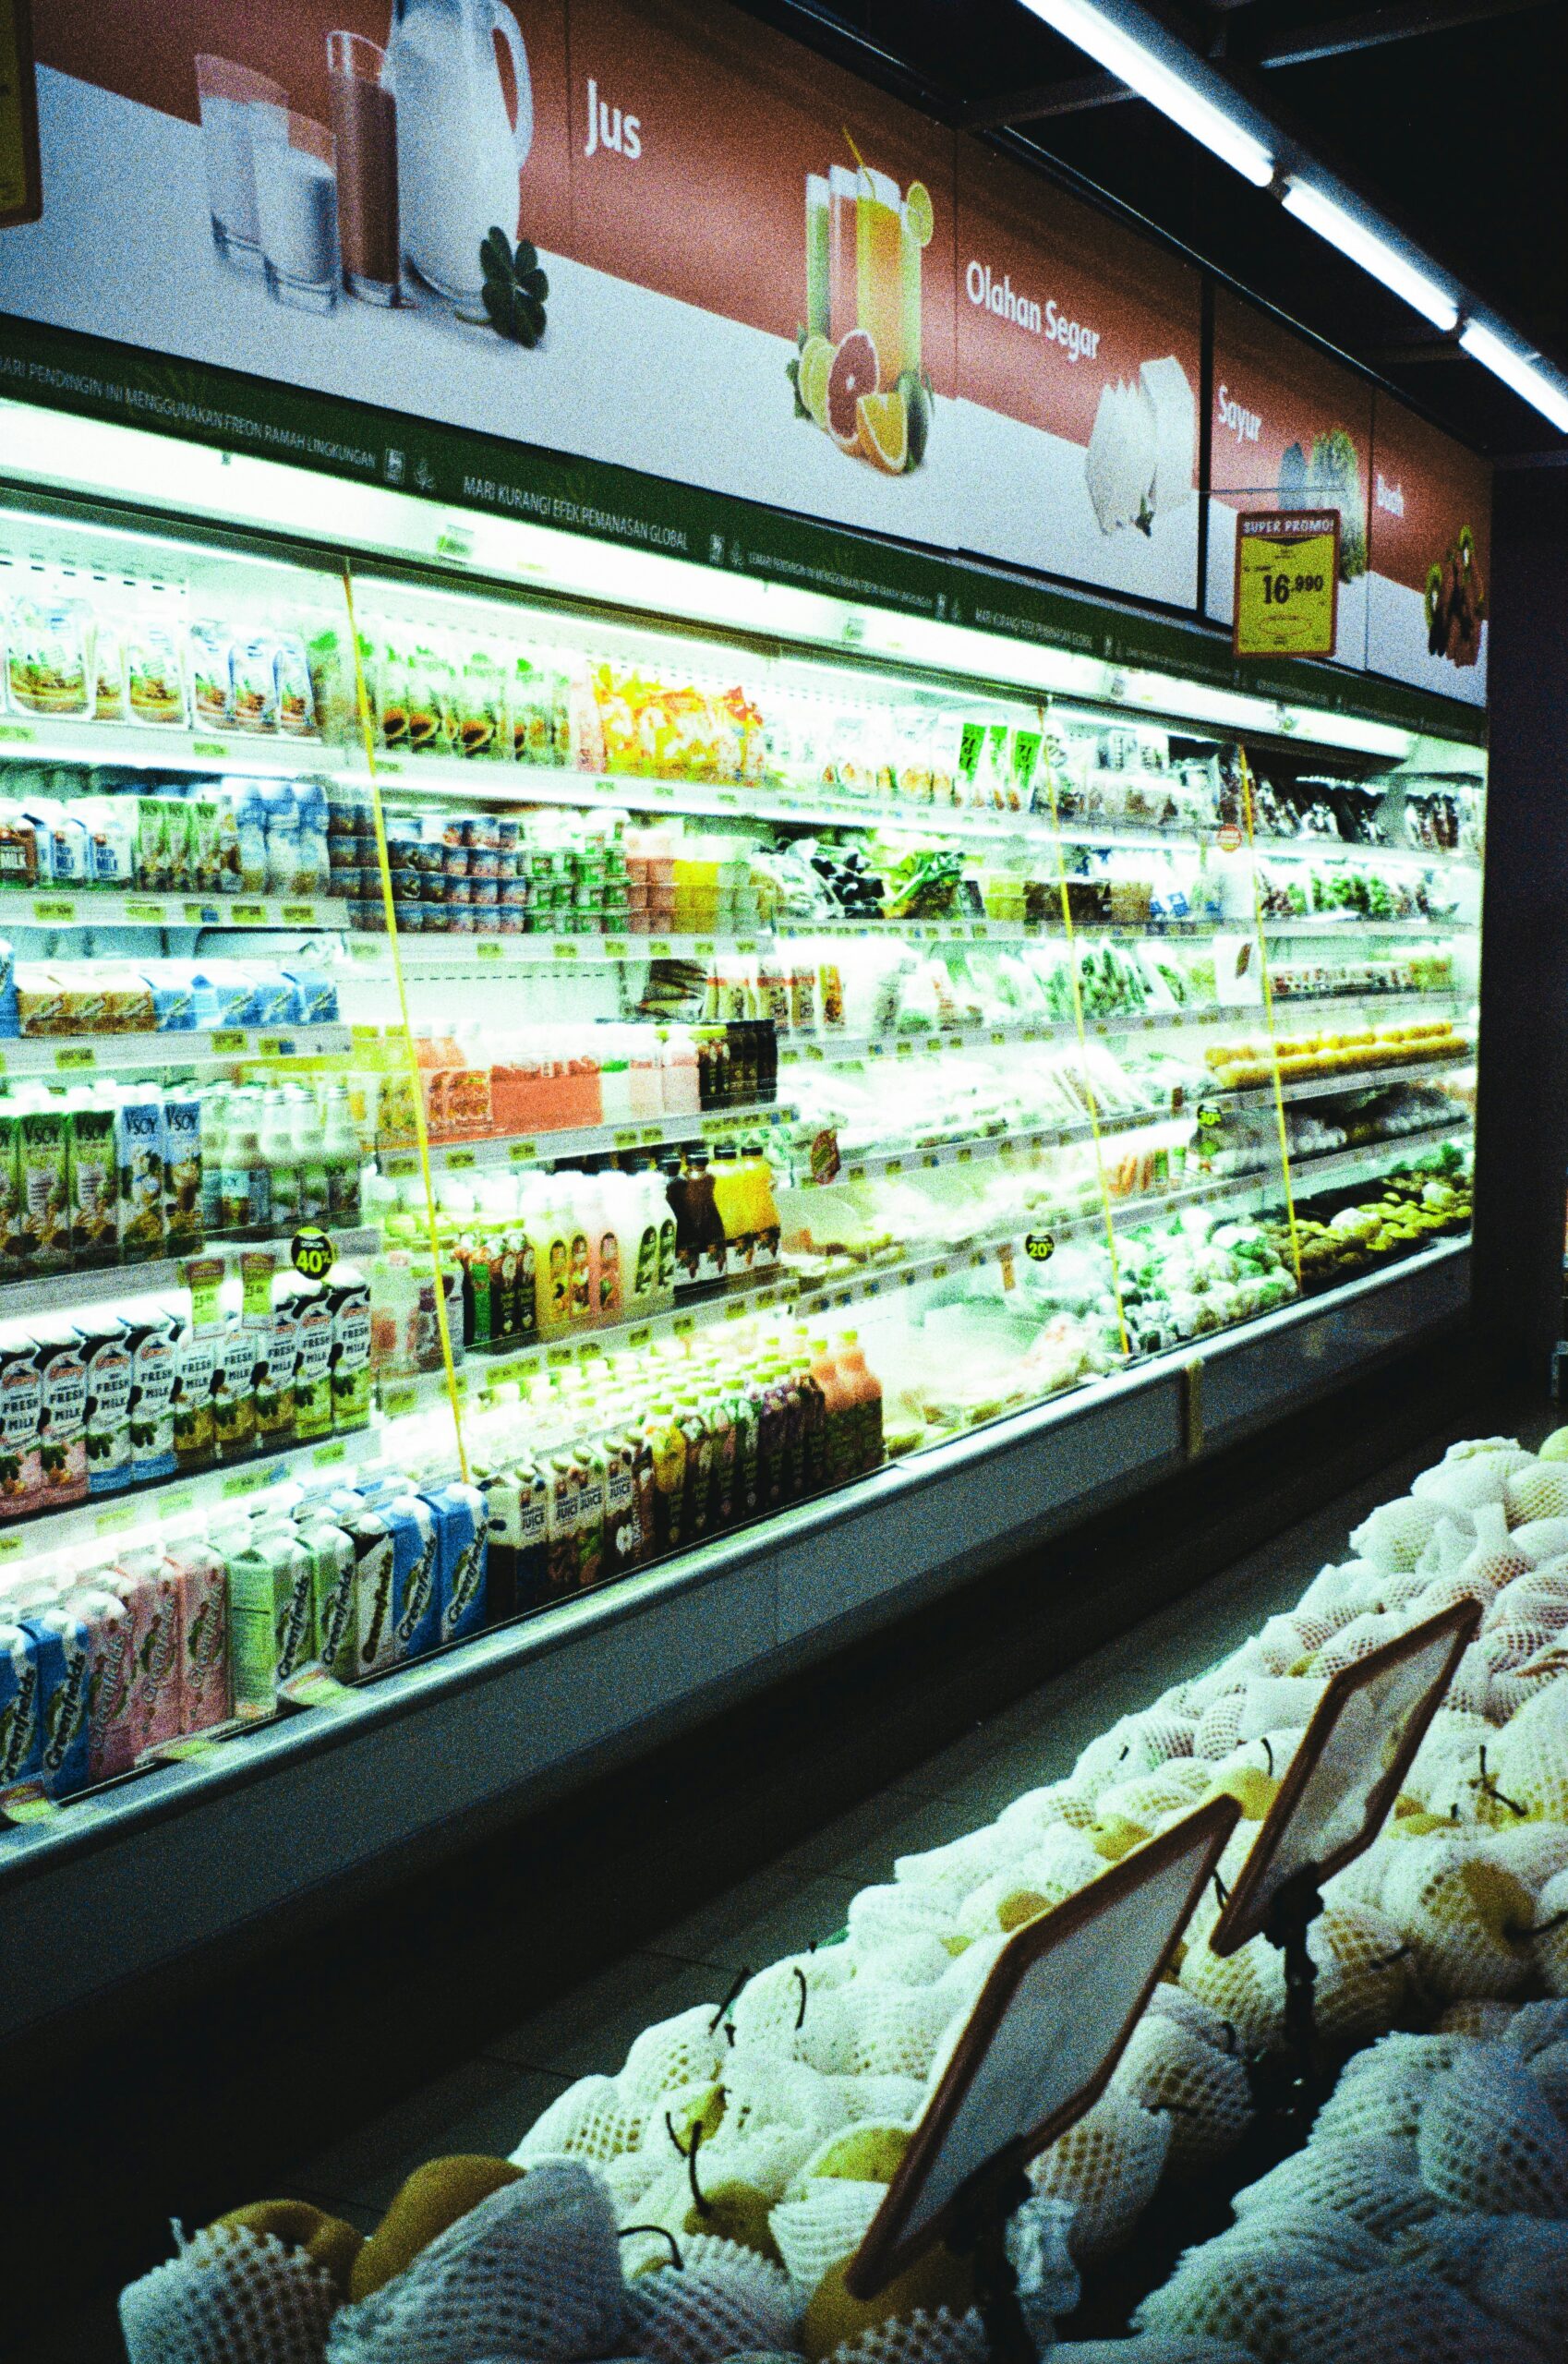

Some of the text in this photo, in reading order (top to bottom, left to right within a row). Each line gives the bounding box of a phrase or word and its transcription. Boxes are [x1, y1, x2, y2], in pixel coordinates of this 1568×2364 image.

[585, 78, 642, 159] Jus
[966, 259, 1100, 363] Olahan Segar
[0, 356, 25, 377] ARI
[1217, 384, 1262, 443] Sayur
[464, 476, 495, 501] MARI
[498, 485, 551, 516] KURANGI
[553, 499, 580, 524] EFEK
[583, 506, 647, 539] PEMANASAN
[649, 524, 689, 551] GLOBAL
[1243, 520, 1282, 534] SUPER
[296, 1249, 332, 1273] 40%
[401, 1534, 437, 1641] Greenfields
[449, 1522, 488, 1623] Greenfields
[278, 1574, 309, 1680] Greenfields
[46, 1652, 86, 1770] Greenfields
